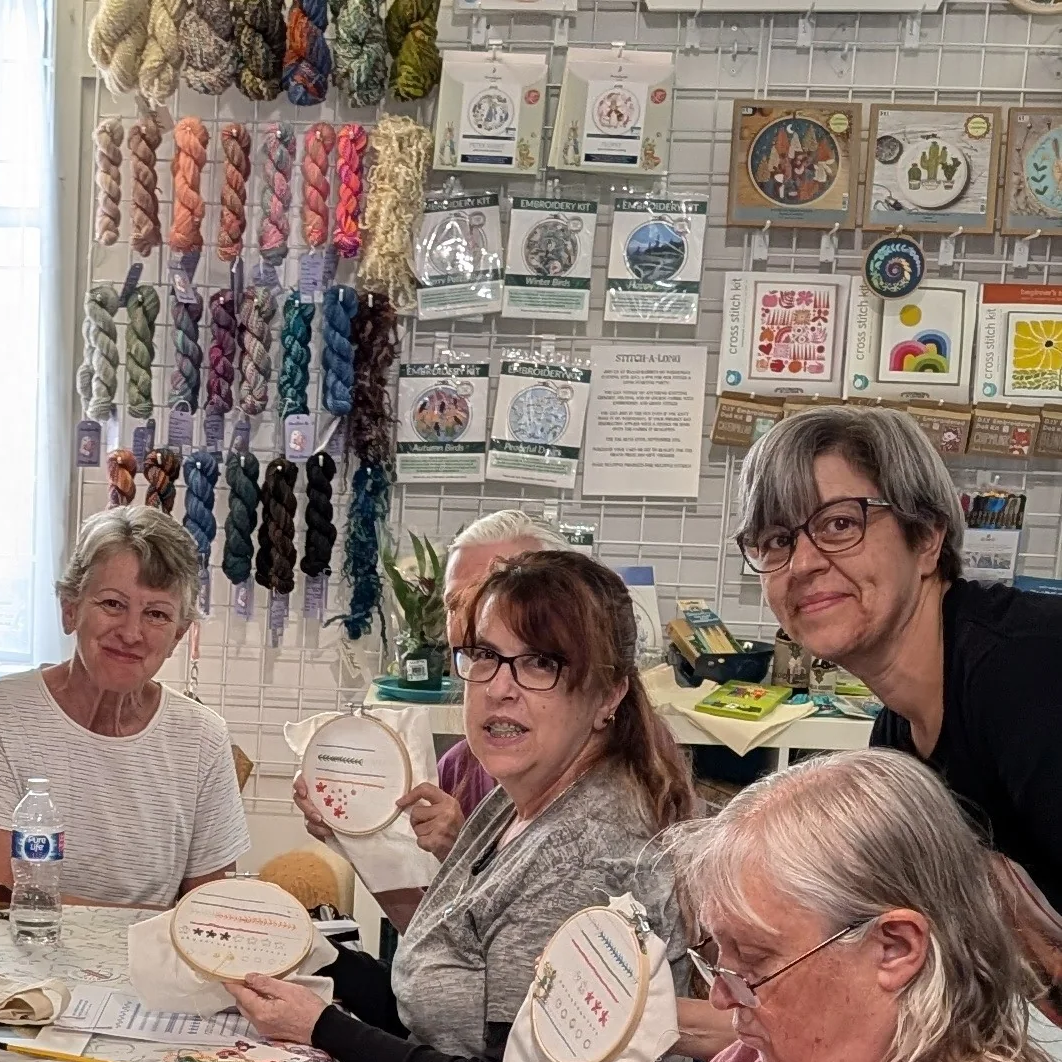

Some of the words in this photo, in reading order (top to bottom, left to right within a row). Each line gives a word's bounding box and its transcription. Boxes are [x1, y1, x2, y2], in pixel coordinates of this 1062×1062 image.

[520, 200, 576, 211] EMBROIDERY
[577, 202, 591, 211] KIT
[526, 276, 550, 285] Winter
[551, 278, 571, 287] Birds
[732, 278, 742, 291] kit
[729, 294, 741, 322] stitch
[856, 300, 868, 329] stitch
[987, 308, 997, 321] kit
[729, 325, 739, 355] cross
[985, 322, 996, 352] stitch
[856, 331, 866, 361] cross
[615, 353, 682, 363] STITCH-A-LONG
[406, 363, 464, 376] EMBROIDERY
[985, 354, 995, 380] cross
[444, 443, 464, 452] Birds
[28, 835, 47, 844] Pure
[30, 842, 44, 852] Life
